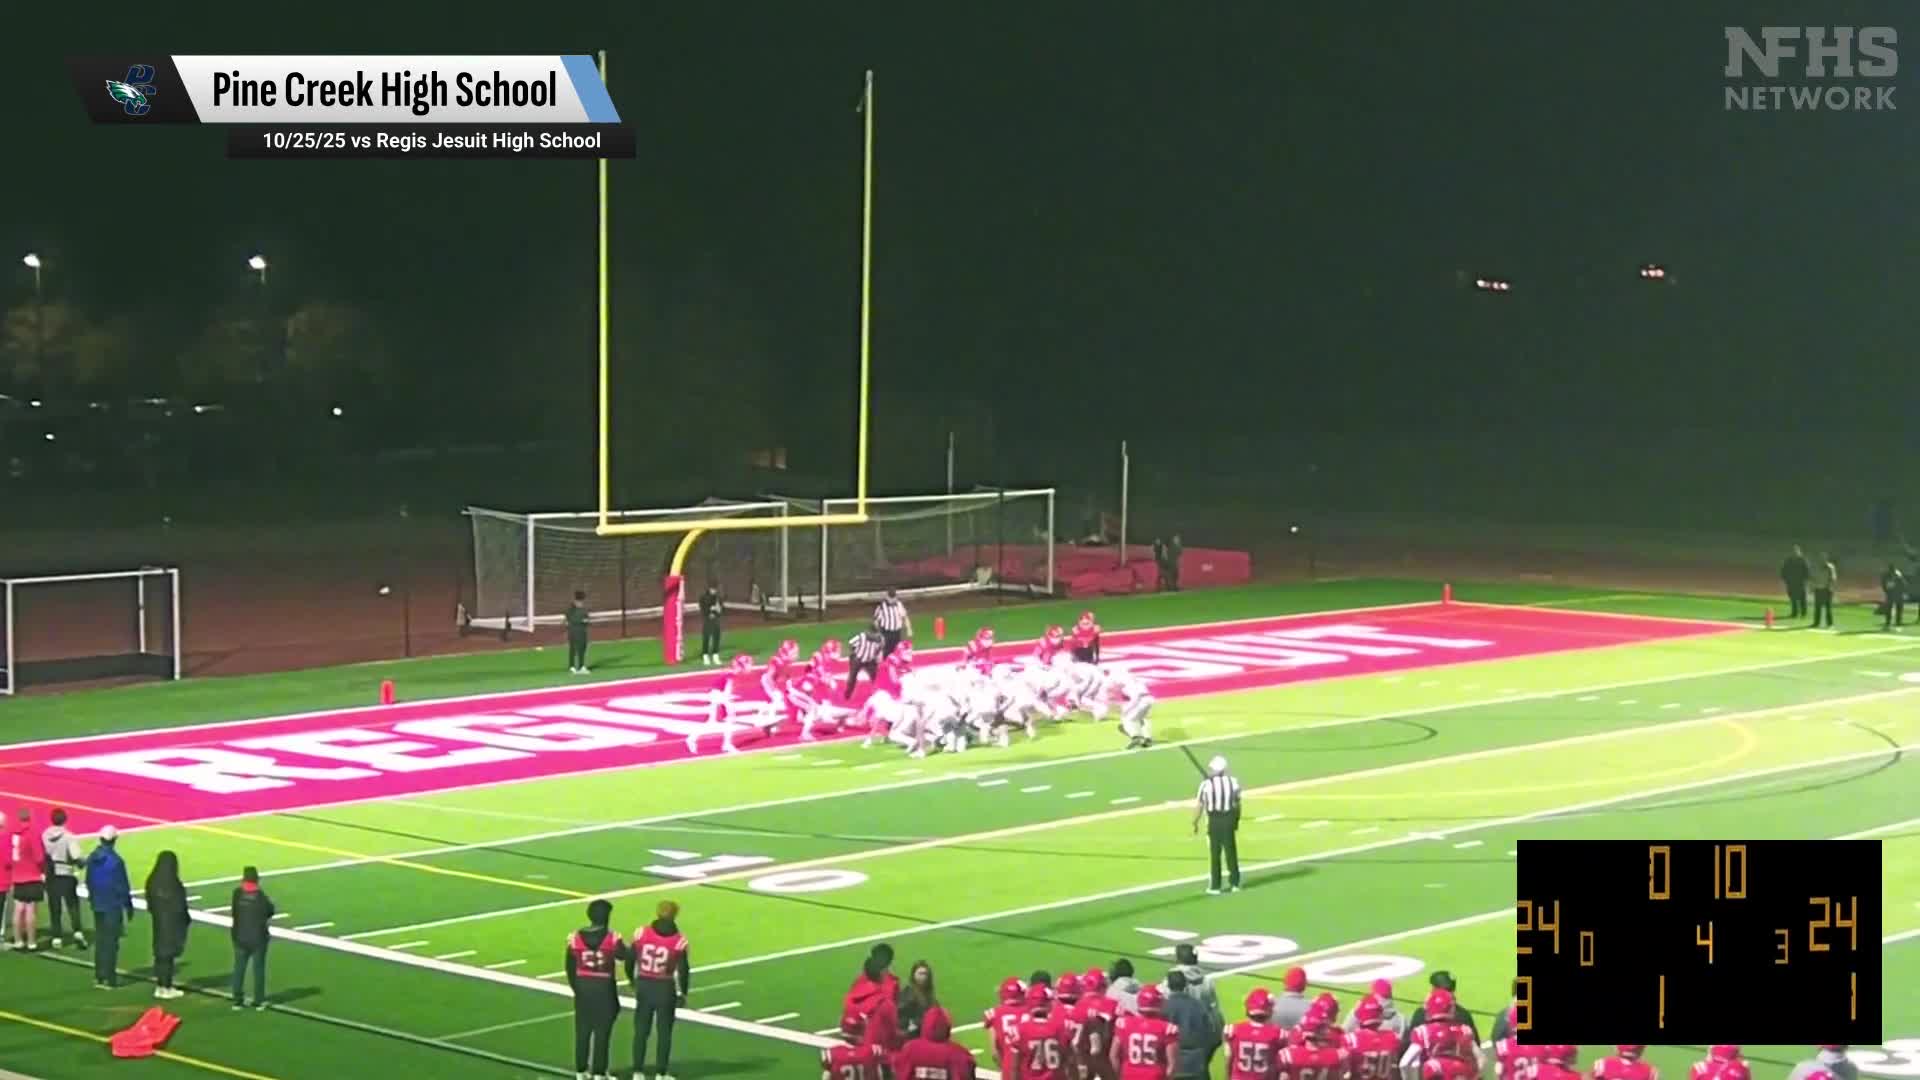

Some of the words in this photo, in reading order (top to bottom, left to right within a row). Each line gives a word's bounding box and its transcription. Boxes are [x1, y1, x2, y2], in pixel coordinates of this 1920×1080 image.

[641, 943, 669, 973] 52
[1027, 1038, 1060, 1070] 76
[1128, 1032, 1158, 1065] 65
[1238, 1041, 1269, 1073] 55
